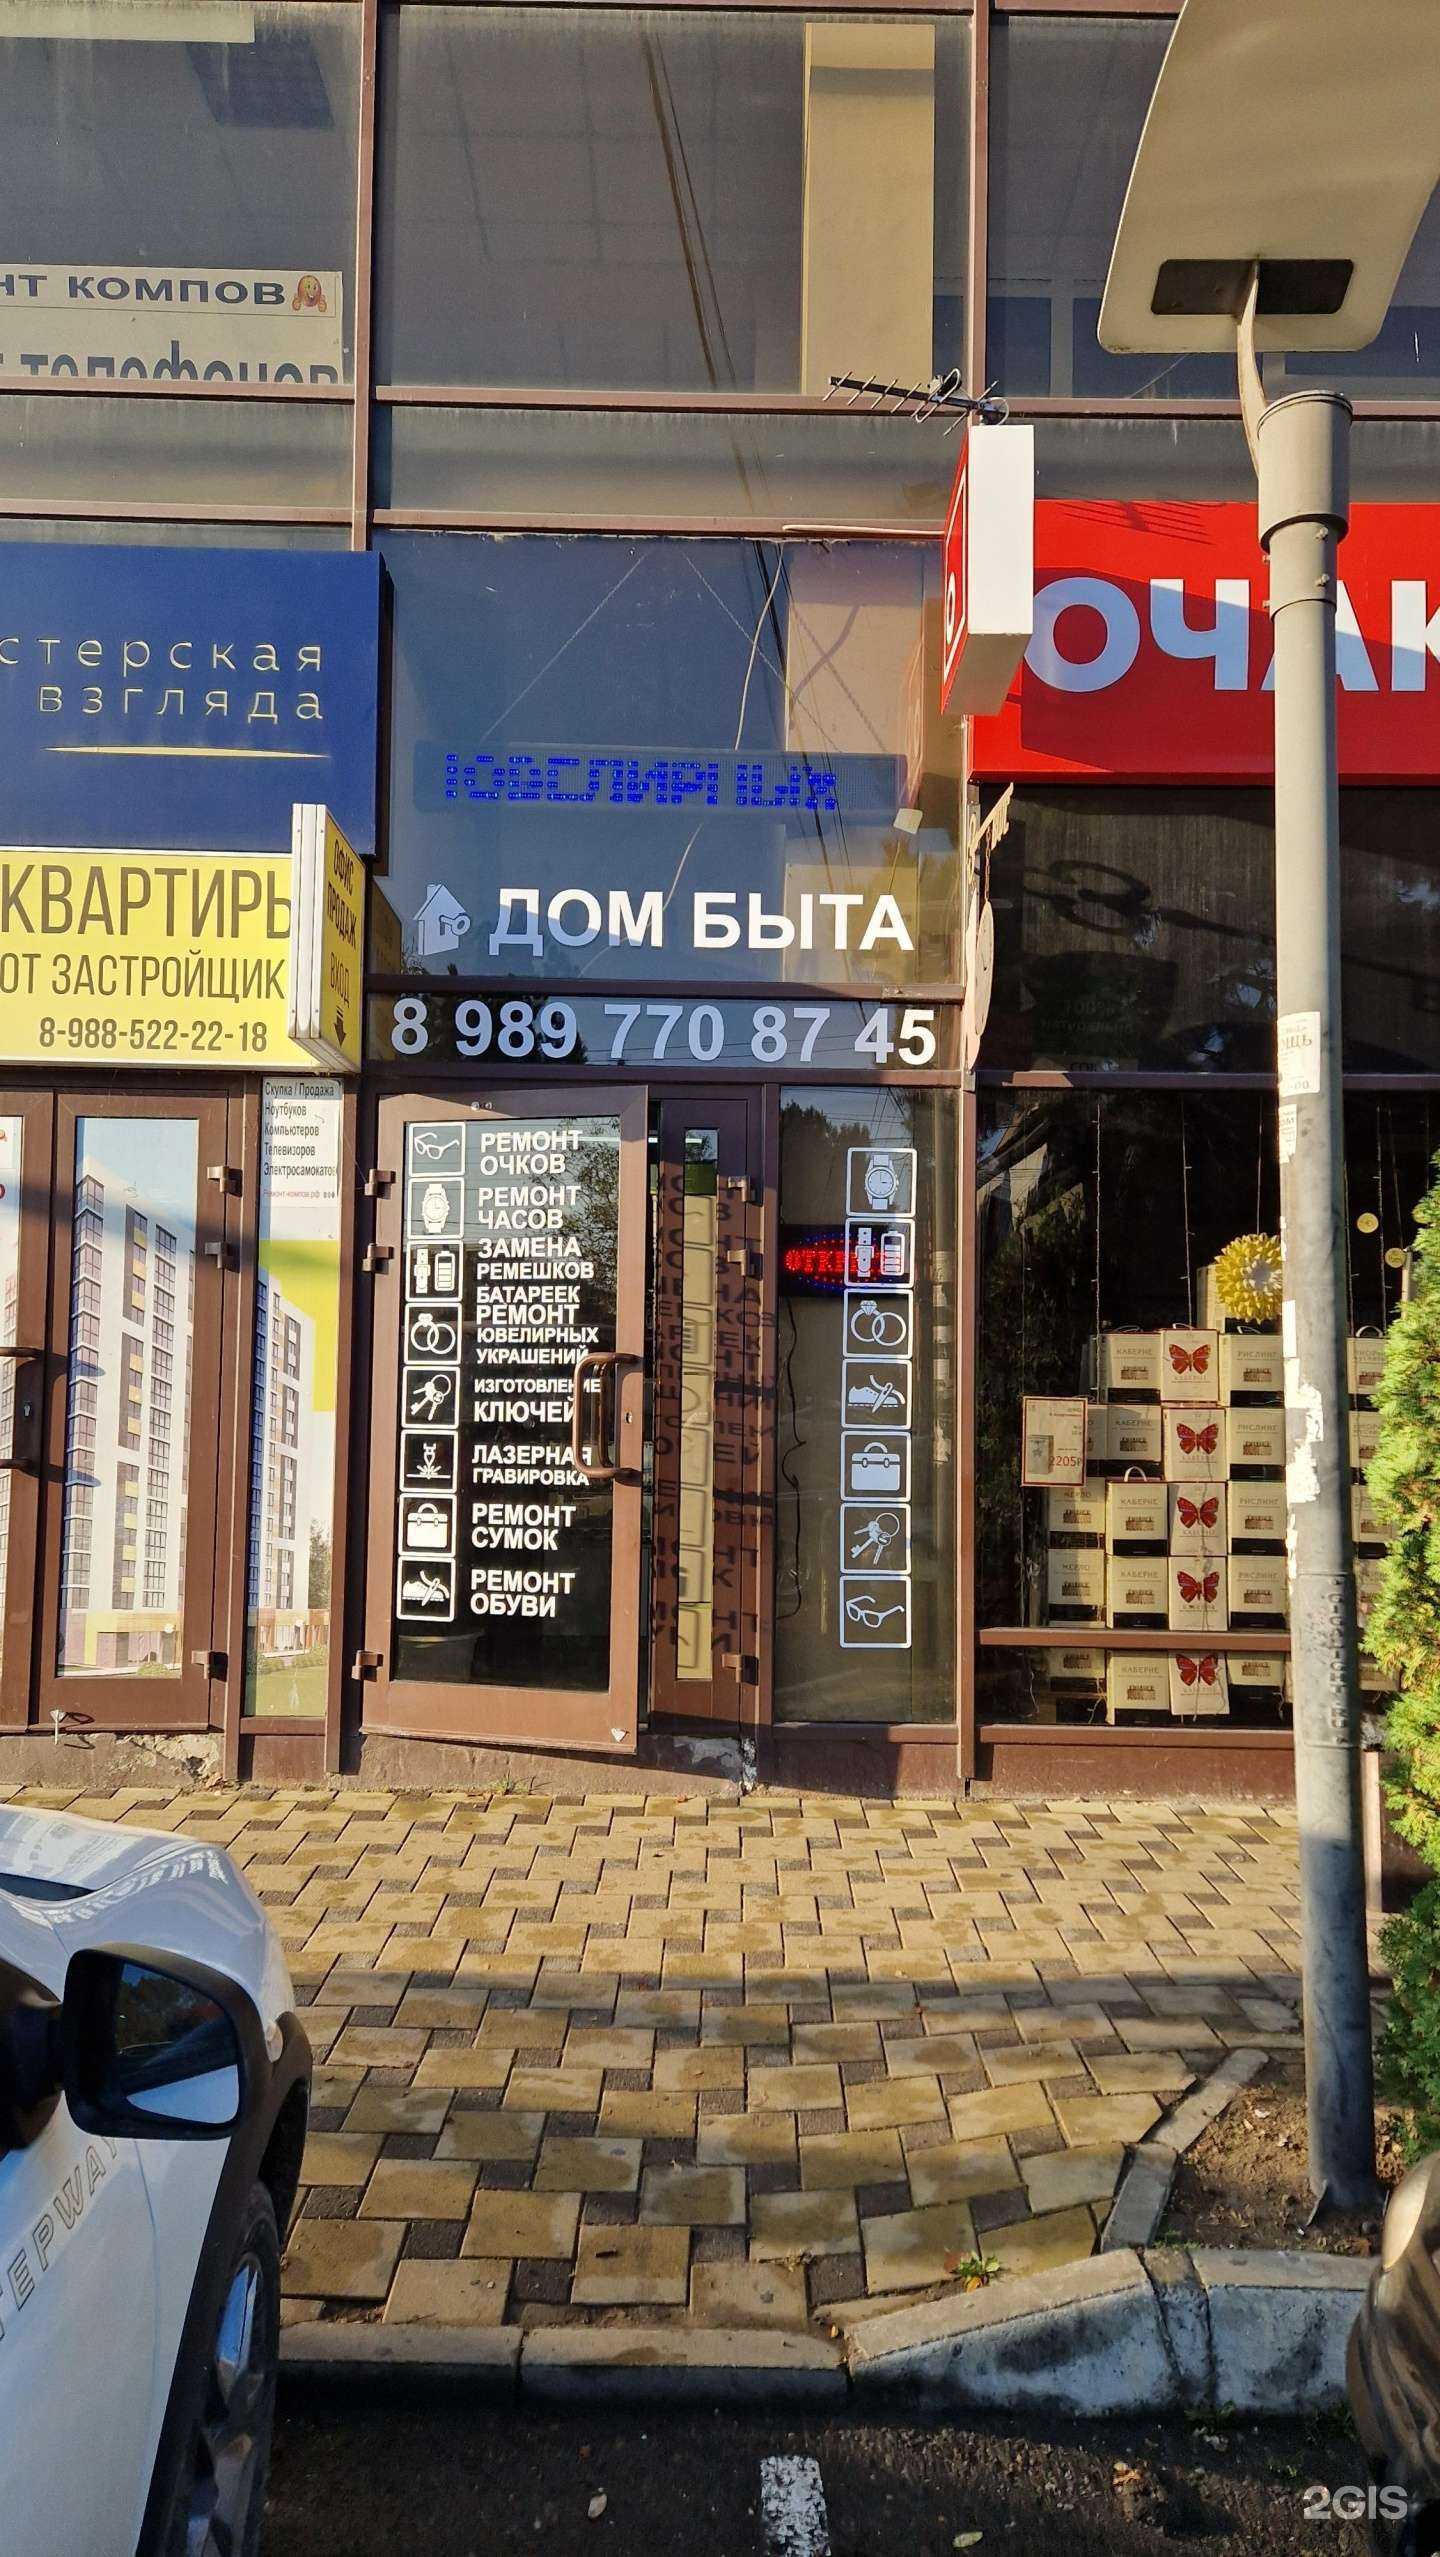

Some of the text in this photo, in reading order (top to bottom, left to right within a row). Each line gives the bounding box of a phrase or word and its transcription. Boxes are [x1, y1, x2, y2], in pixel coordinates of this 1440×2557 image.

[68, 275, 286, 305] КОМПОВ
[0, 638, 322, 677] стерская
[38, 685, 323, 724] взгляда
[333, 838, 355, 897] ОФИС
[327, 877, 358, 951] ПРОДАЖ
[488, 887, 914, 957] ДОМ БЫТА
[0, 949, 286, 1004] ОТ ЗАСТРОЙЩИК
[330, 951, 350, 1009] ВХОД
[40, 1016, 268, 1052] 8-988-522-22-18
[391, 997, 936, 1066] 8 989 770 87 45
[265, 1082, 292, 1099] Скупка
[300, 1083, 334, 1099] Продажа
[265, 1102, 306, 1120] Ноутбуков
[264, 1123, 320, 1139] Компьютеров
[480, 1130, 583, 1152] РЕМОНТ
[264, 1142, 316, 1159] Телевизоров
[480, 1153, 566, 1175] ОЧКОВ
[478, 1185, 581, 1207] РЕМОНТ
[478, 1209, 564, 1230] ЧАСОВ
[478, 1237, 582, 1258] ЗАМЕНА
[476, 1262, 595, 1280] РЕМЕШКОВ
[476, 1285, 581, 1304] БАТАРЕЕК
[476, 1304, 580, 1325] РЕМОНТ
[476, 1327, 599, 1343] ЮВЕЛИРНЫХ
[476, 1345, 589, 1365] УКРАШЕНИЙ
[474, 1396, 576, 1423] КЛЮЧЕЙ
[472, 1445, 592, 1466] ЛАЗЕРНАЯ
[472, 1468, 590, 1486] ГРАВИРОВКА
[471, 1503, 576, 1528] РЕМОНТ
[471, 1526, 559, 1550] СУМОК
[471, 1570, 576, 1594] РЕМОНТ
[470, 1593, 556, 1618] ОБУВИ
[0, 2138, 117, 2341] EPWA
